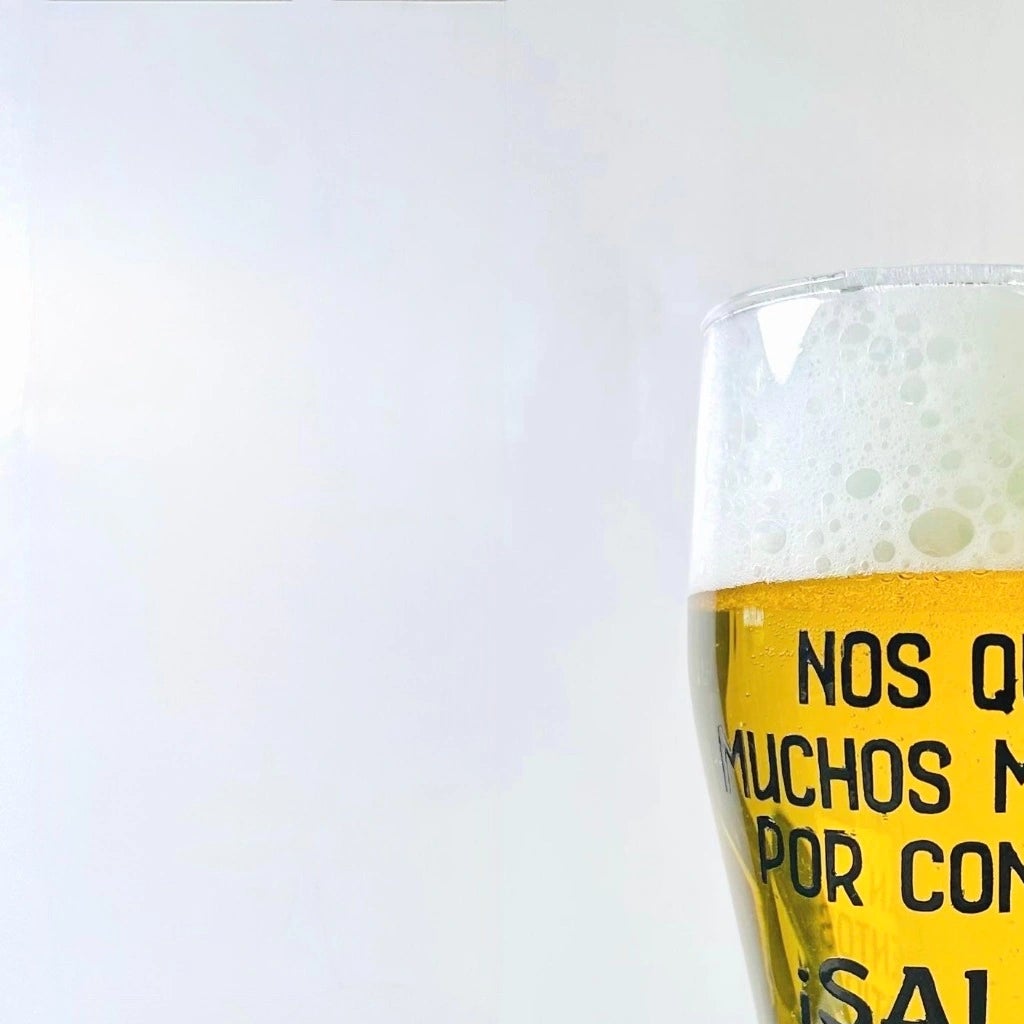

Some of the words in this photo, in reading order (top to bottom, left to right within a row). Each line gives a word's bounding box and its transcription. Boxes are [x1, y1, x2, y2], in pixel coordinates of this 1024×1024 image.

[798, 630, 930, 708] NOS
[717, 725, 952, 814] MUCHOS
[756, 815, 863, 907] POR
